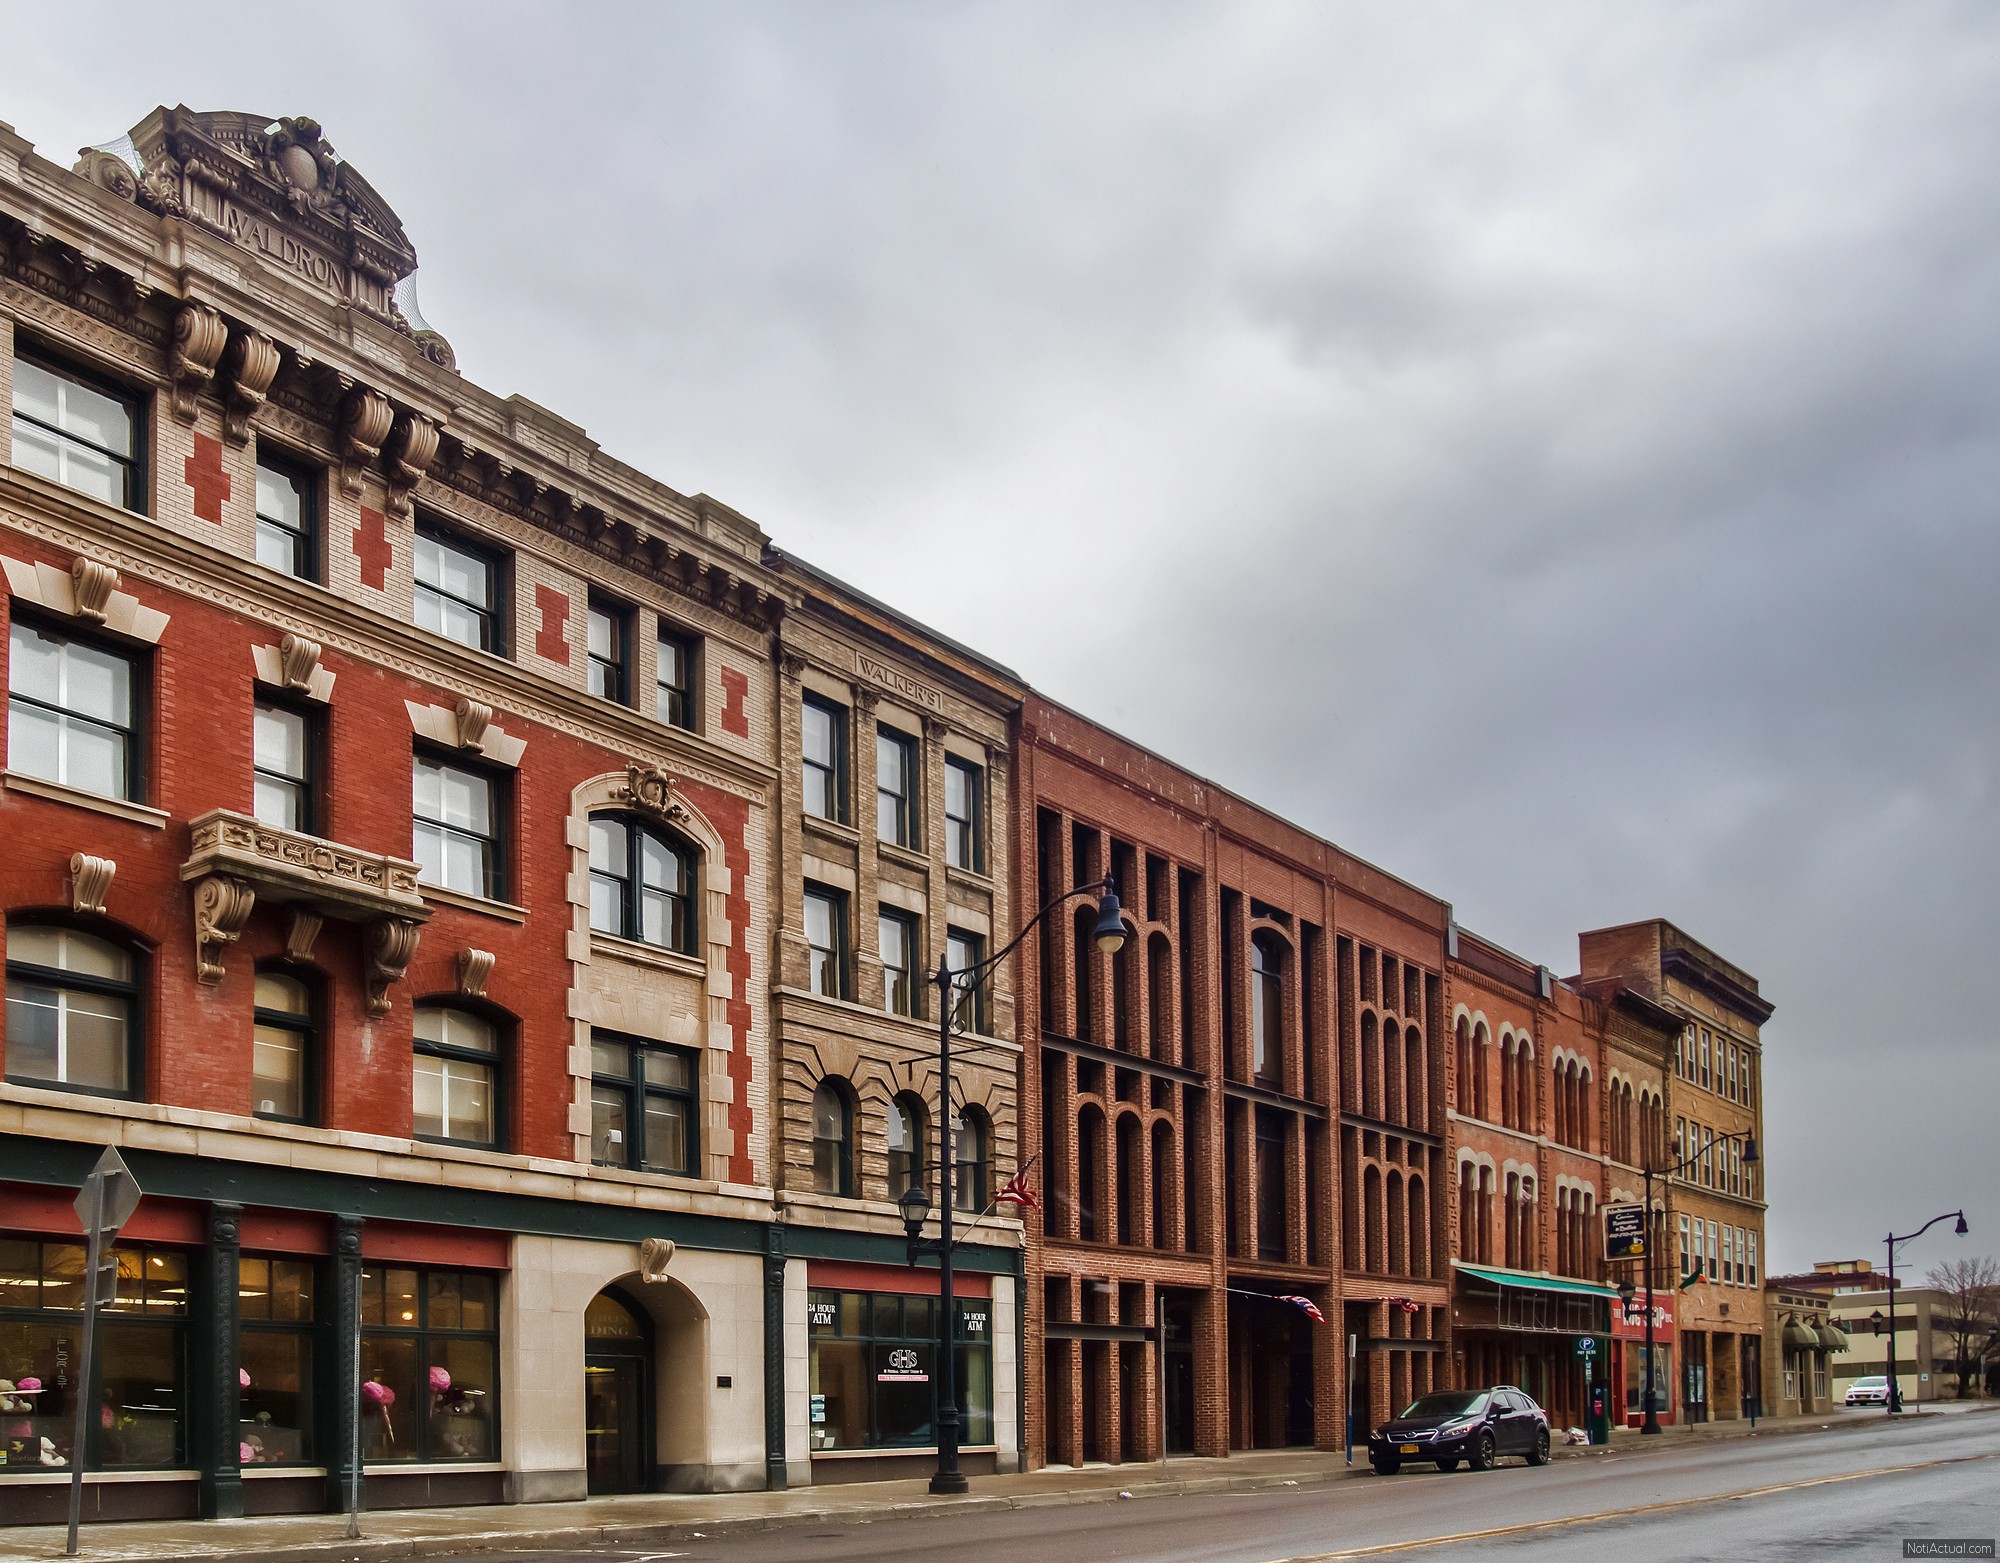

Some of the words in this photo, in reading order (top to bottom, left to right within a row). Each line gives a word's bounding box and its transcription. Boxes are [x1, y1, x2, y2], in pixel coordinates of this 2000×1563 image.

[228, 208, 344, 296] WALDRON
[860, 658, 936, 706] WALKER'S
[809, 1303, 816, 1312] 24
[817, 1304, 836, 1313] HOUR
[963, 1312, 970, 1321] 24
[971, 1312, 987, 1321] HOUR
[1642, 1304, 1665, 1328] SOP
[812, 1312, 832, 1325] ATM
[967, 1321, 983, 1331] ATM
[56, 1339, 69, 1389] FLORIST
[889, 1349, 918, 1369] GHS
